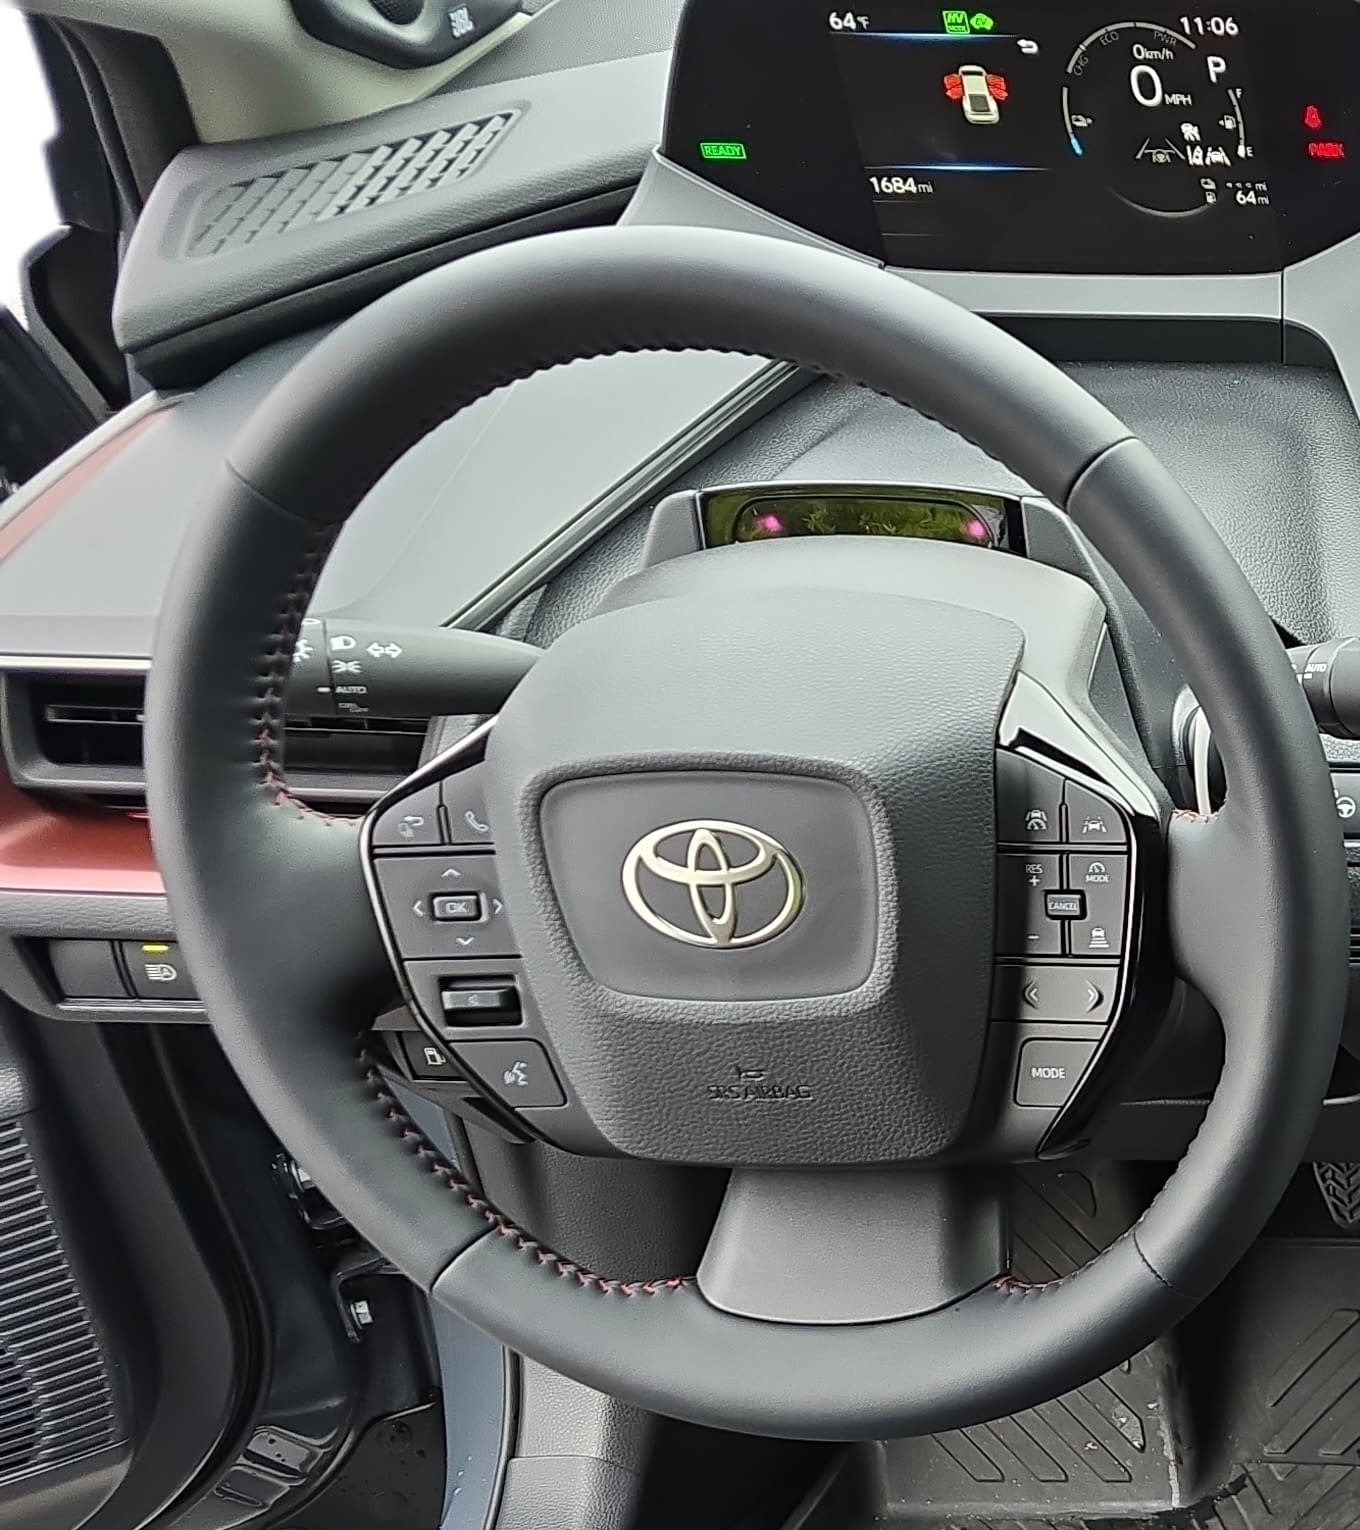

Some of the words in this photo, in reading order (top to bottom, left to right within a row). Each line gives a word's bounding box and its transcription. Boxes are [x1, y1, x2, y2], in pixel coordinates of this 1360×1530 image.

[1180, 16, 1239, 36] 11:06
[1100, 31, 1120, 46] ECO
[1153, 30, 1177, 47] PWR
[1073, 56, 1089, 77] CHG
[1207, 56, 1226, 83] P
[1130, 65, 1163, 107] 0
[1164, 94, 1192, 106] MPH
[704, 145, 742, 156] READY
[1304, 663, 1328, 673] AUTO
[335, 686, 368, 694] AUTO
[1026, 863, 1044, 874] RES
[1085, 874, 1110, 883] MODE
[444, 901, 469, 914] OK
[1031, 1066, 1066, 1080] MODE
